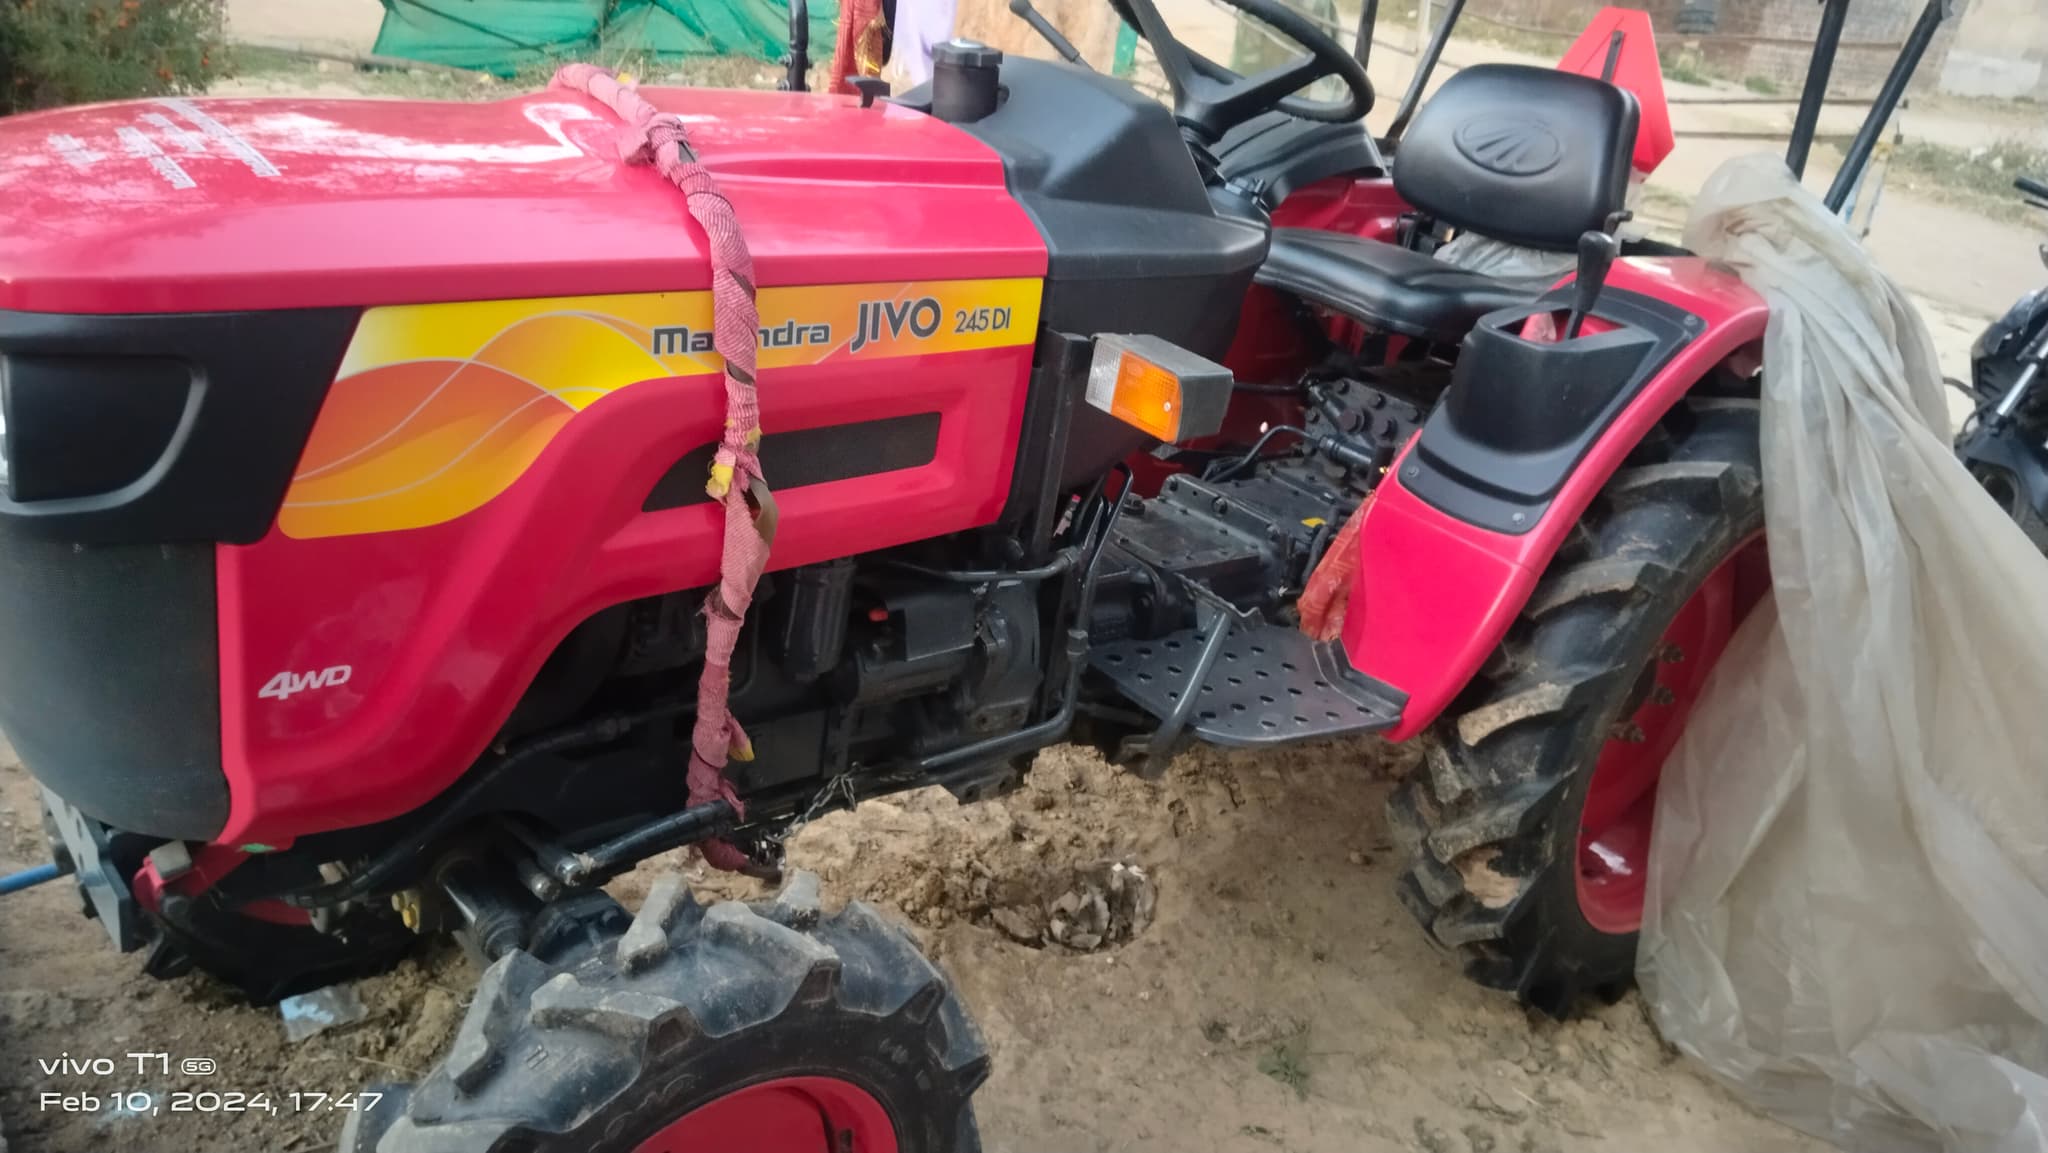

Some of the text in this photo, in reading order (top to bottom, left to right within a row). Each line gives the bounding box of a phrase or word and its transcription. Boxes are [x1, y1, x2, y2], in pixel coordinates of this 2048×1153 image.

[653, 320, 831, 355] Mandra
[851, 297, 941, 352] JIVO
[258, 665, 352, 700] 4WD
